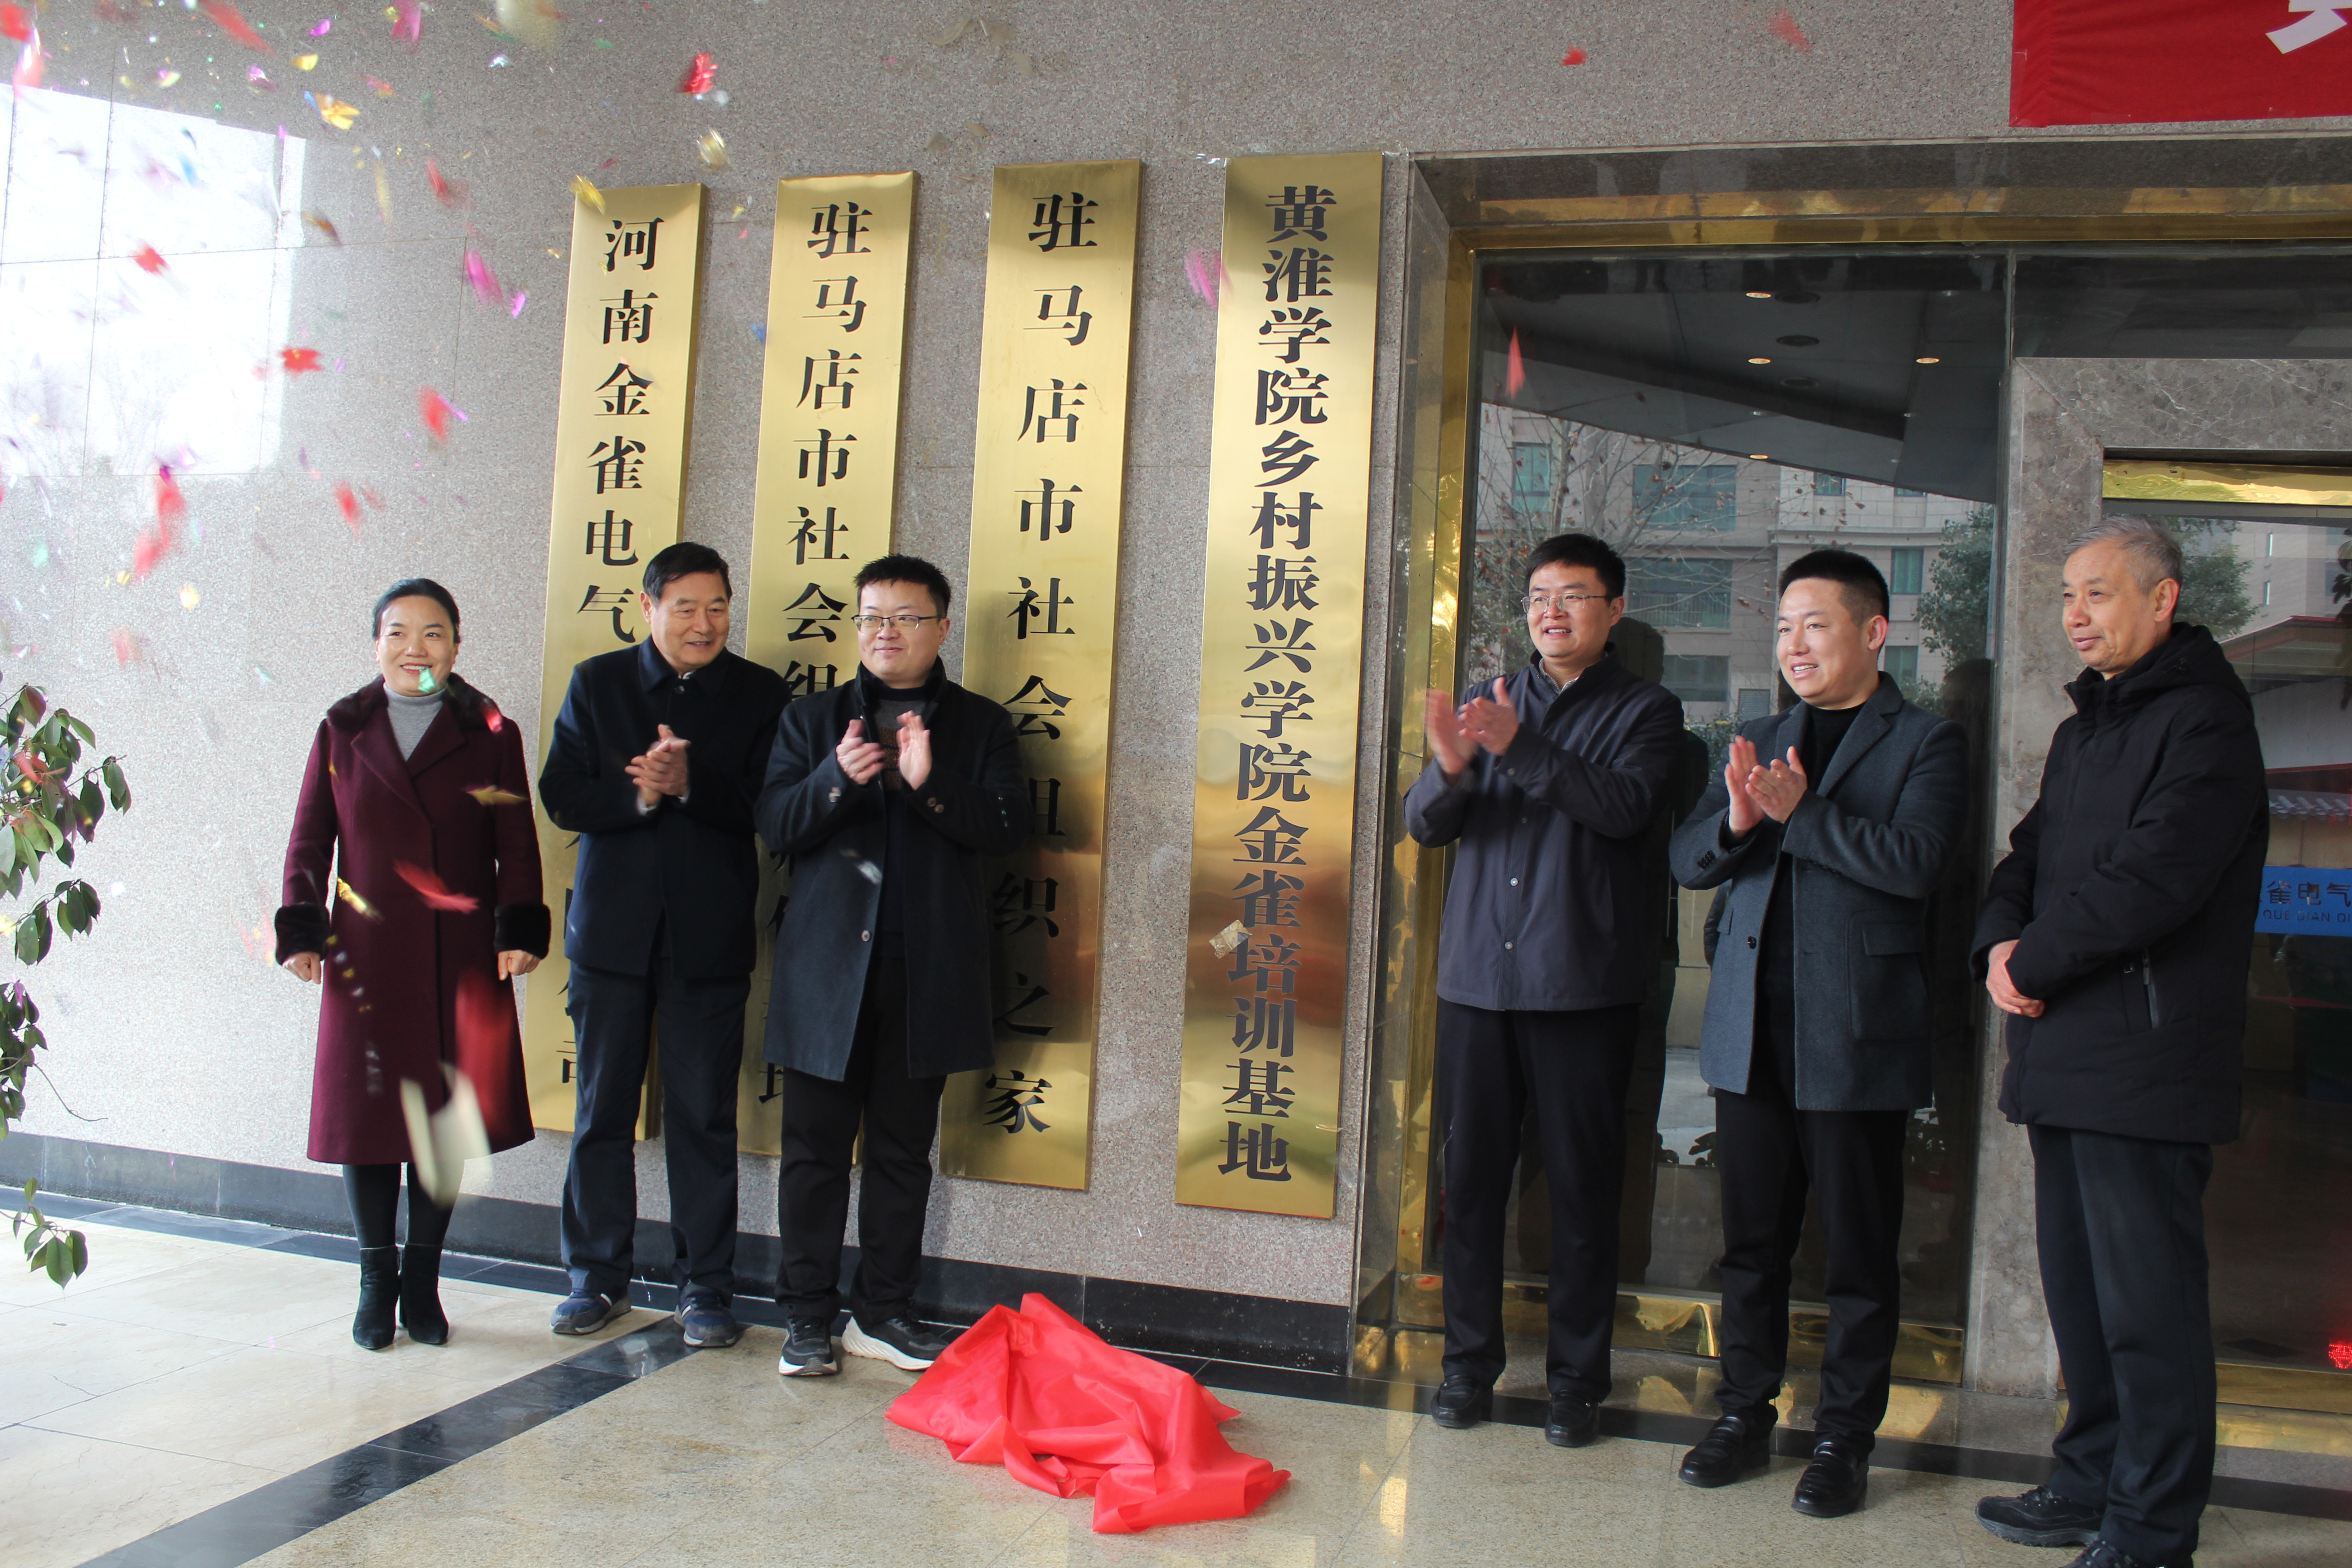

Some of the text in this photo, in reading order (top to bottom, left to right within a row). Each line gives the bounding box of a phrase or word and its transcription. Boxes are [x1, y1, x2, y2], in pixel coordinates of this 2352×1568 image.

[1218, 185, 1337, 1181] 黄淮学院乡村振兴学院金雀培训基地
[2259, 880, 2351, 907] 雀电气
[2263, 909, 2351, 923] QUE DIAN QI
